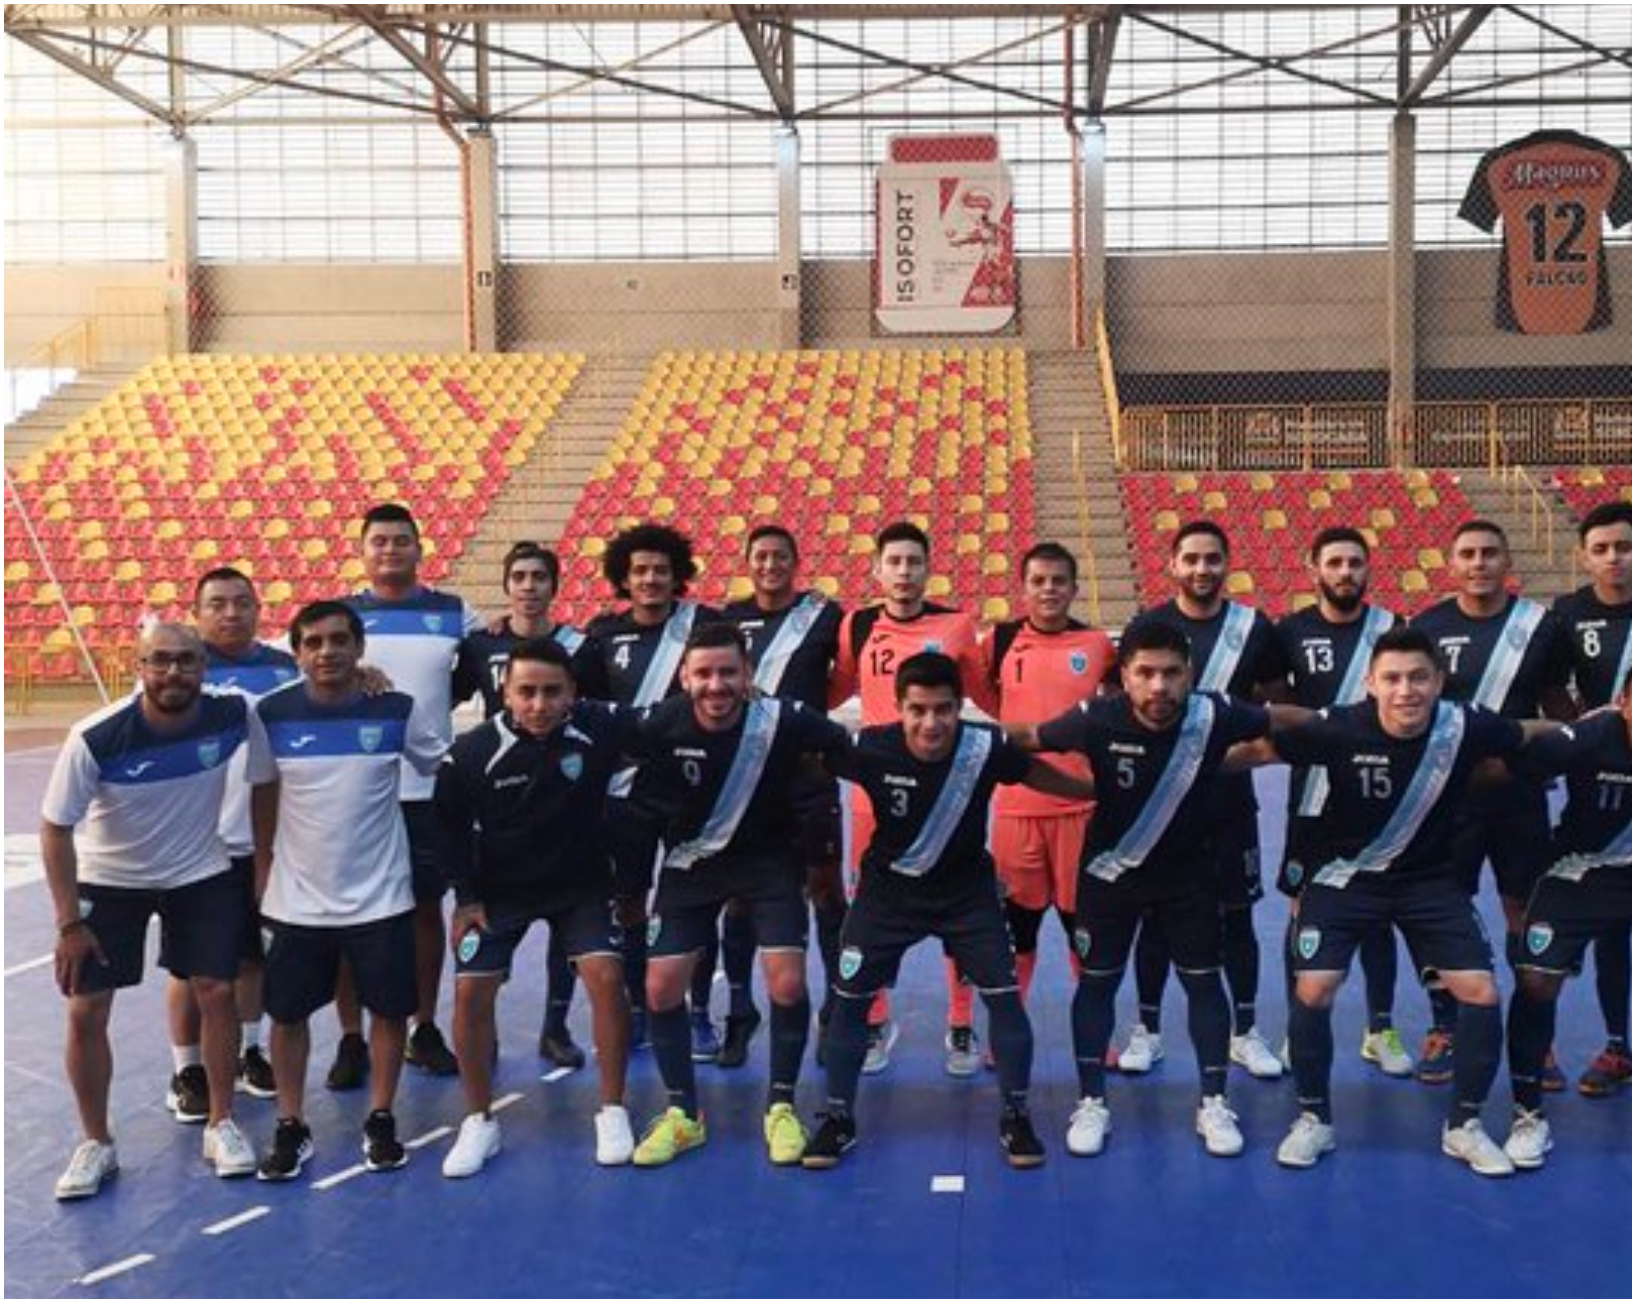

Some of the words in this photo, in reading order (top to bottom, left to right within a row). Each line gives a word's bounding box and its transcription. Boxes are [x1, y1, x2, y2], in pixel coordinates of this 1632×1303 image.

[1525, 201, 1588, 263] 12
[896, 190, 915, 303] ISOFORT
[615, 645, 631, 670] 4
[1584, 630, 1600, 657] 8
[870, 649, 895, 676] 12
[1015, 657, 1023, 683] 1
[1305, 646, 1334, 673] 13
[1445, 645, 1461, 674] 7
[1117, 758, 1135, 788] 5
[1359, 767, 1392, 798] 15
[890, 788, 908, 816] 3
